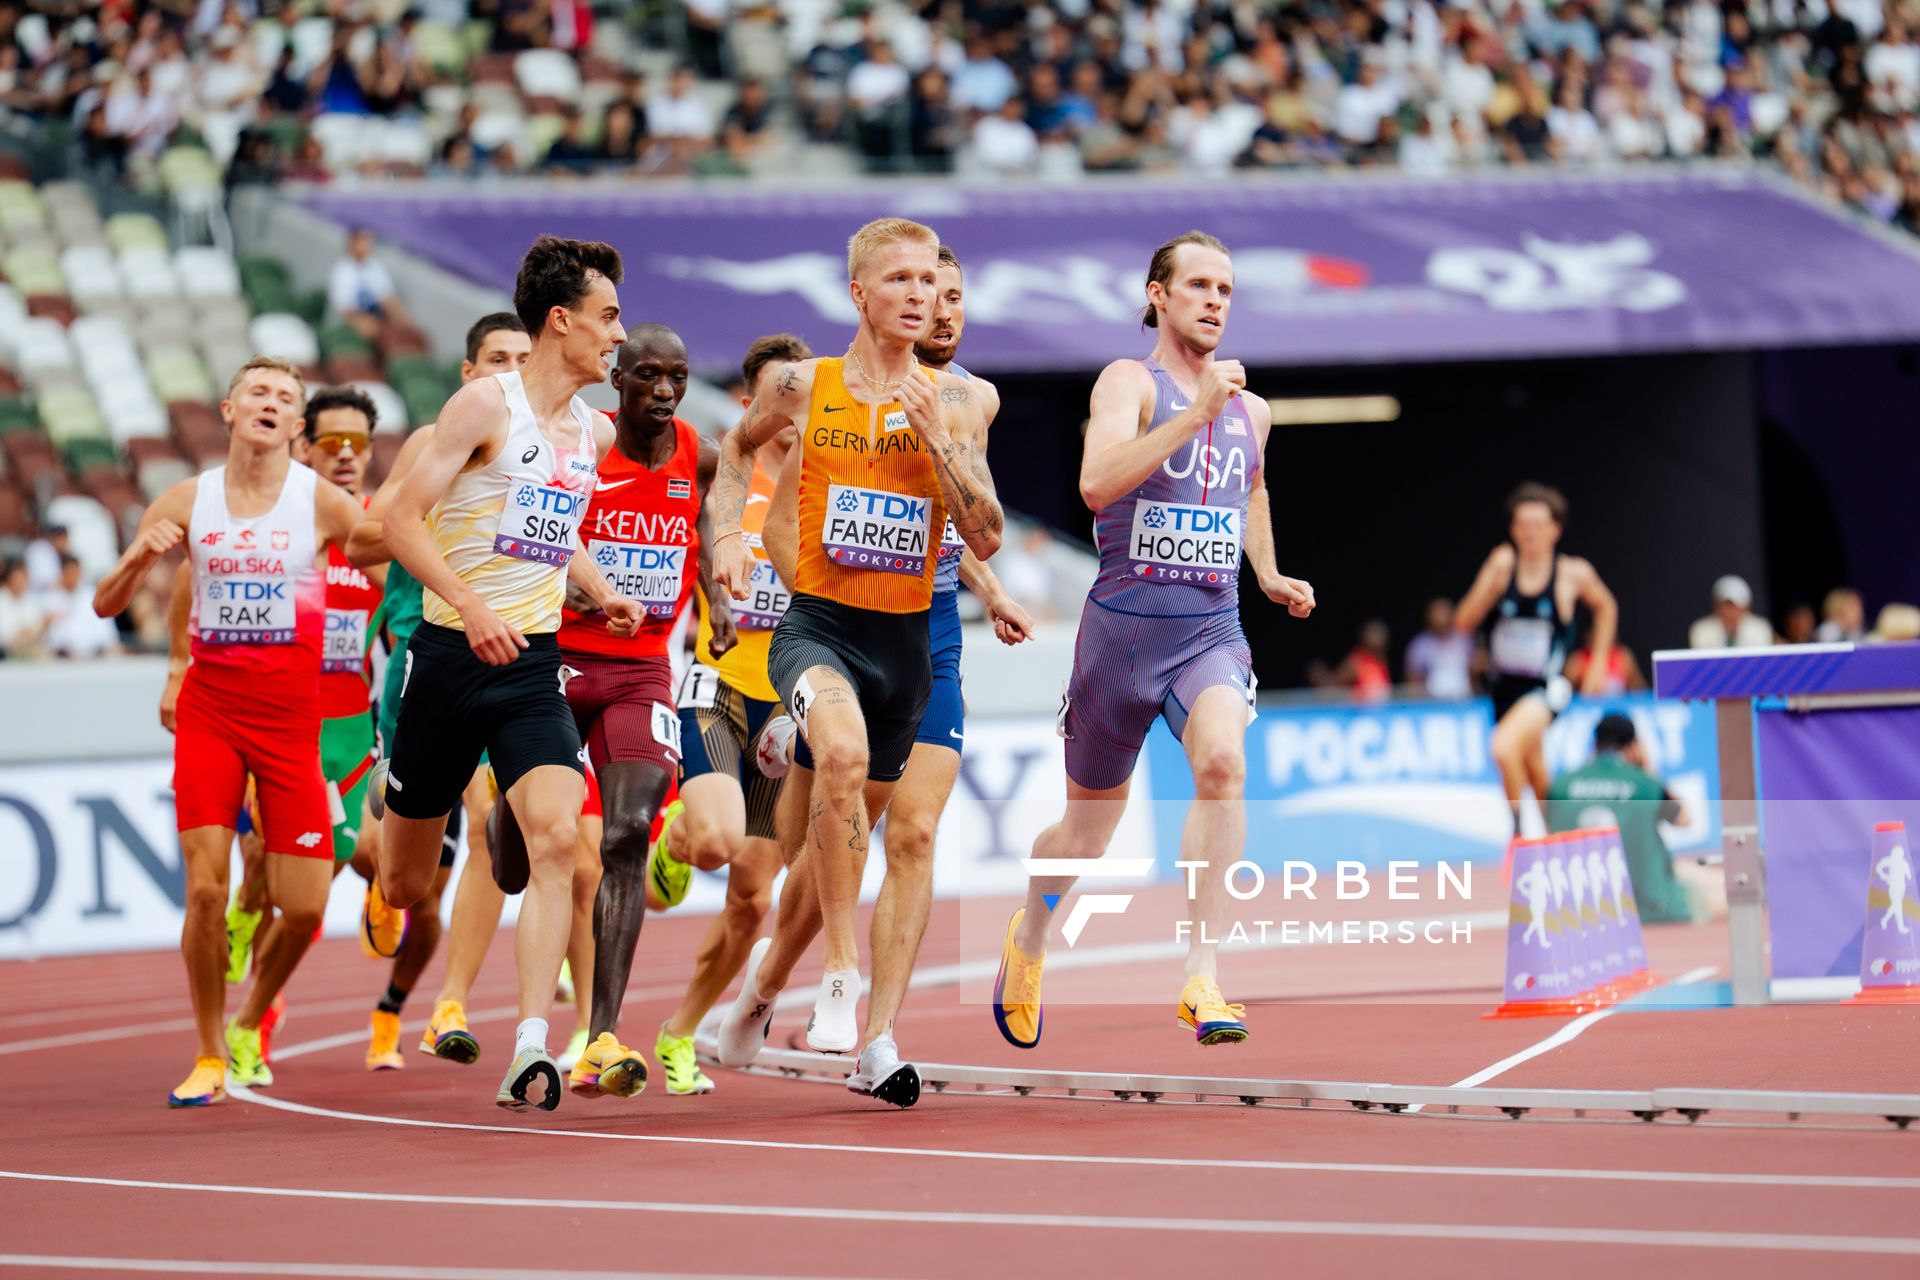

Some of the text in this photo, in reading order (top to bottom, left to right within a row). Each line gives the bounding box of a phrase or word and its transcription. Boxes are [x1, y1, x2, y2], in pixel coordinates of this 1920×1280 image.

[813, 428, 928, 455] GERMAN
[1163, 438, 1246, 492] USA
[537, 487, 585, 517] TDK
[860, 492, 926, 523] TDK
[523, 515, 571, 545] SISK
[595, 508, 688, 543] KENYA
[1167, 508, 1234, 534] TDK
[829, 518, 925, 553] FARKEN
[522, 544, 570, 563] TOKYO2
[619, 547, 679, 570] TDK
[848, 551, 922, 571] TOKYO25
[1137, 534, 1235, 564] HOCKER
[208, 558, 285, 575] POLSKA
[327, 566, 370, 590] UGAL
[224, 582, 285, 600] TDK
[220, 606, 272, 625] RAK
[325, 615, 358, 632] DK
[1266, 711, 1486, 787] POCARI
